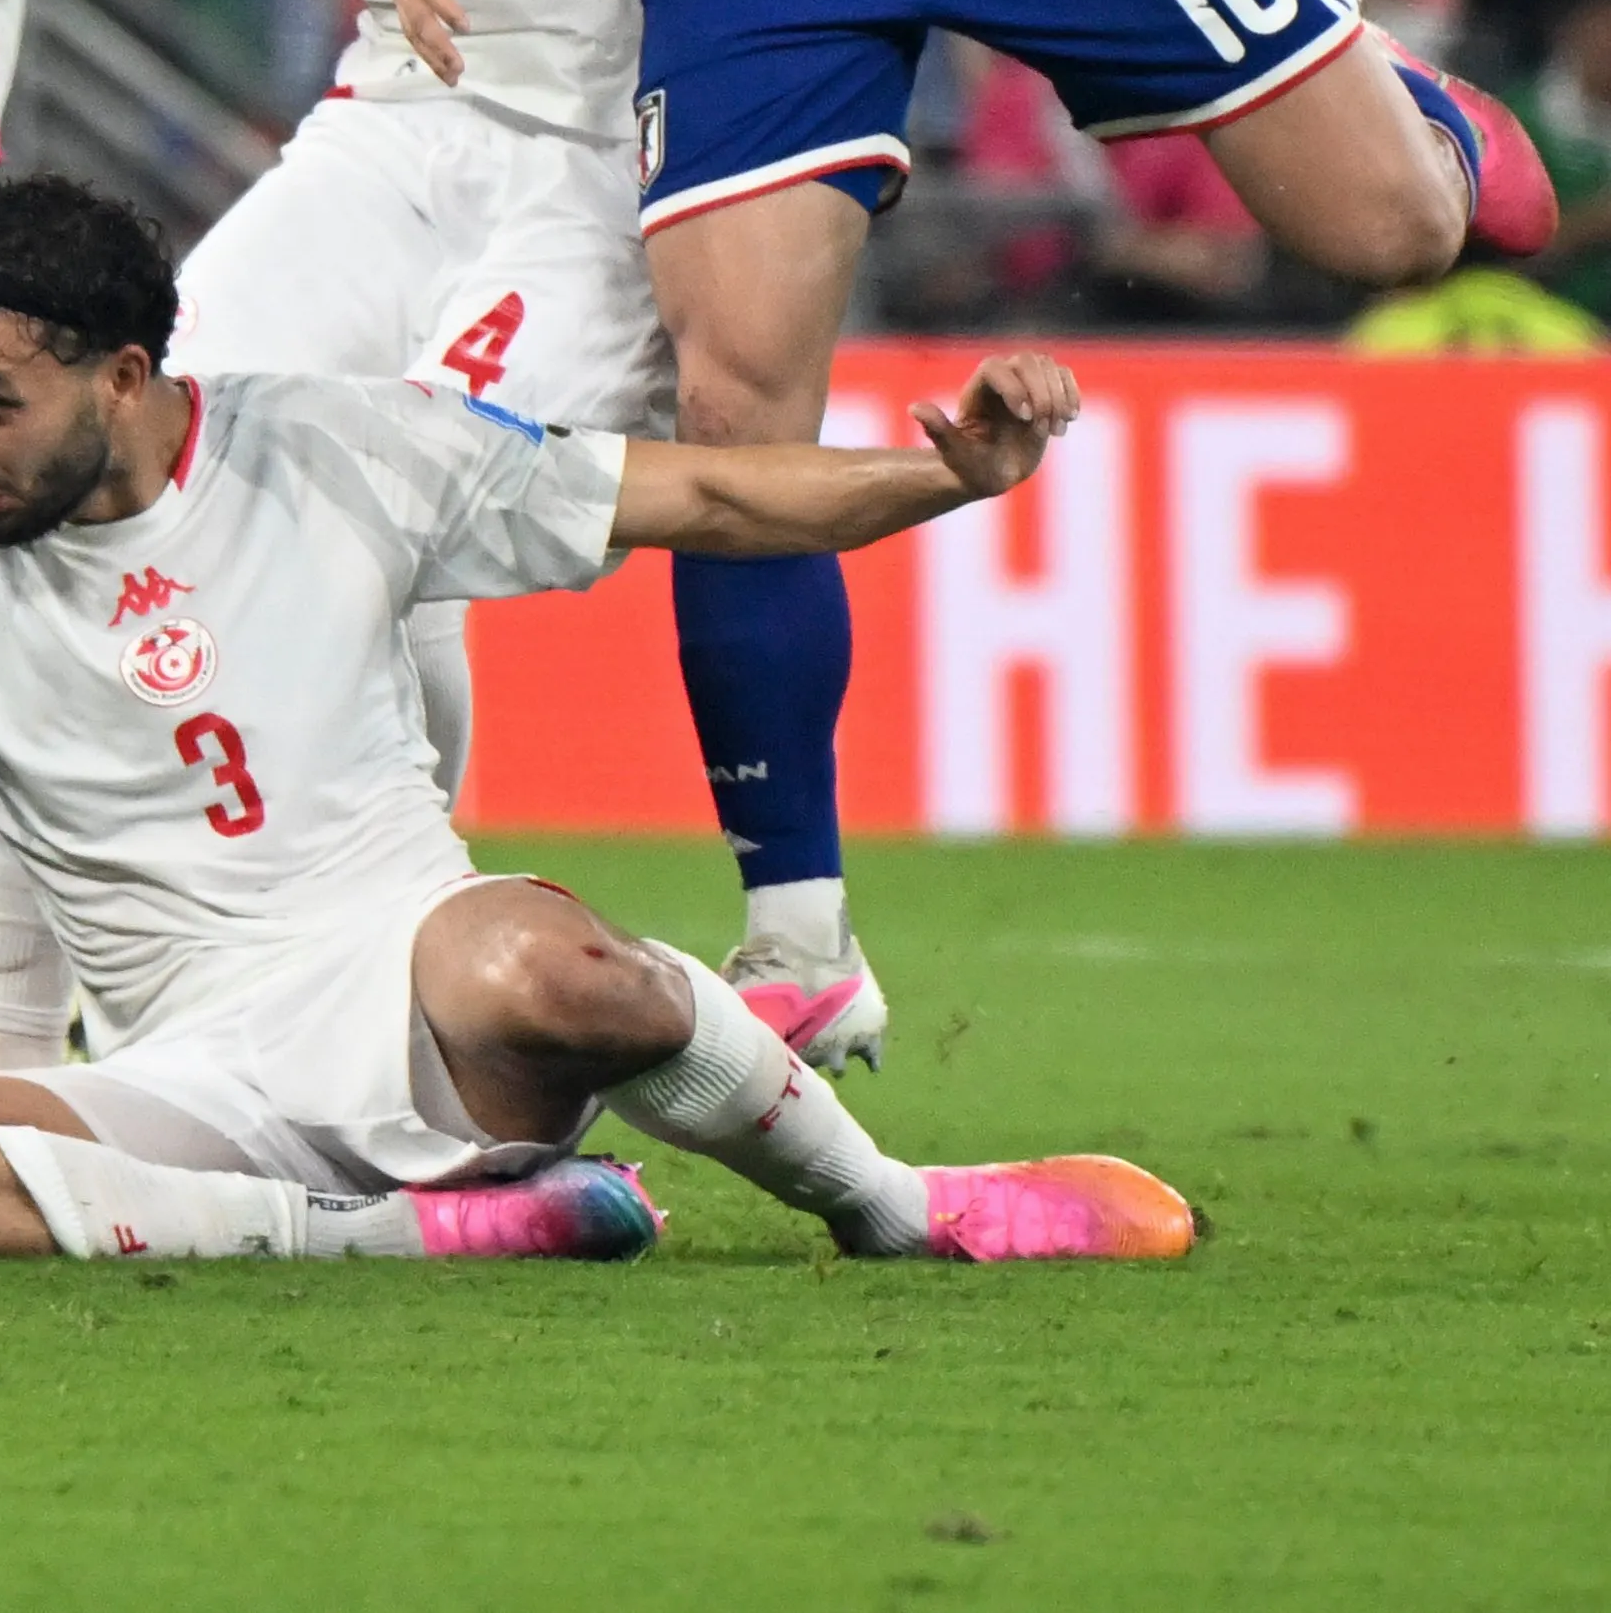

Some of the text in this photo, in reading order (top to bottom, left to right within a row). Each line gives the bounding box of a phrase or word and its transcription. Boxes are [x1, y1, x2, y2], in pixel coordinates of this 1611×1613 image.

[441, 290, 525, 400] 4
[821, 397, 1356, 837] HE
[173, 712, 266, 837] 3
